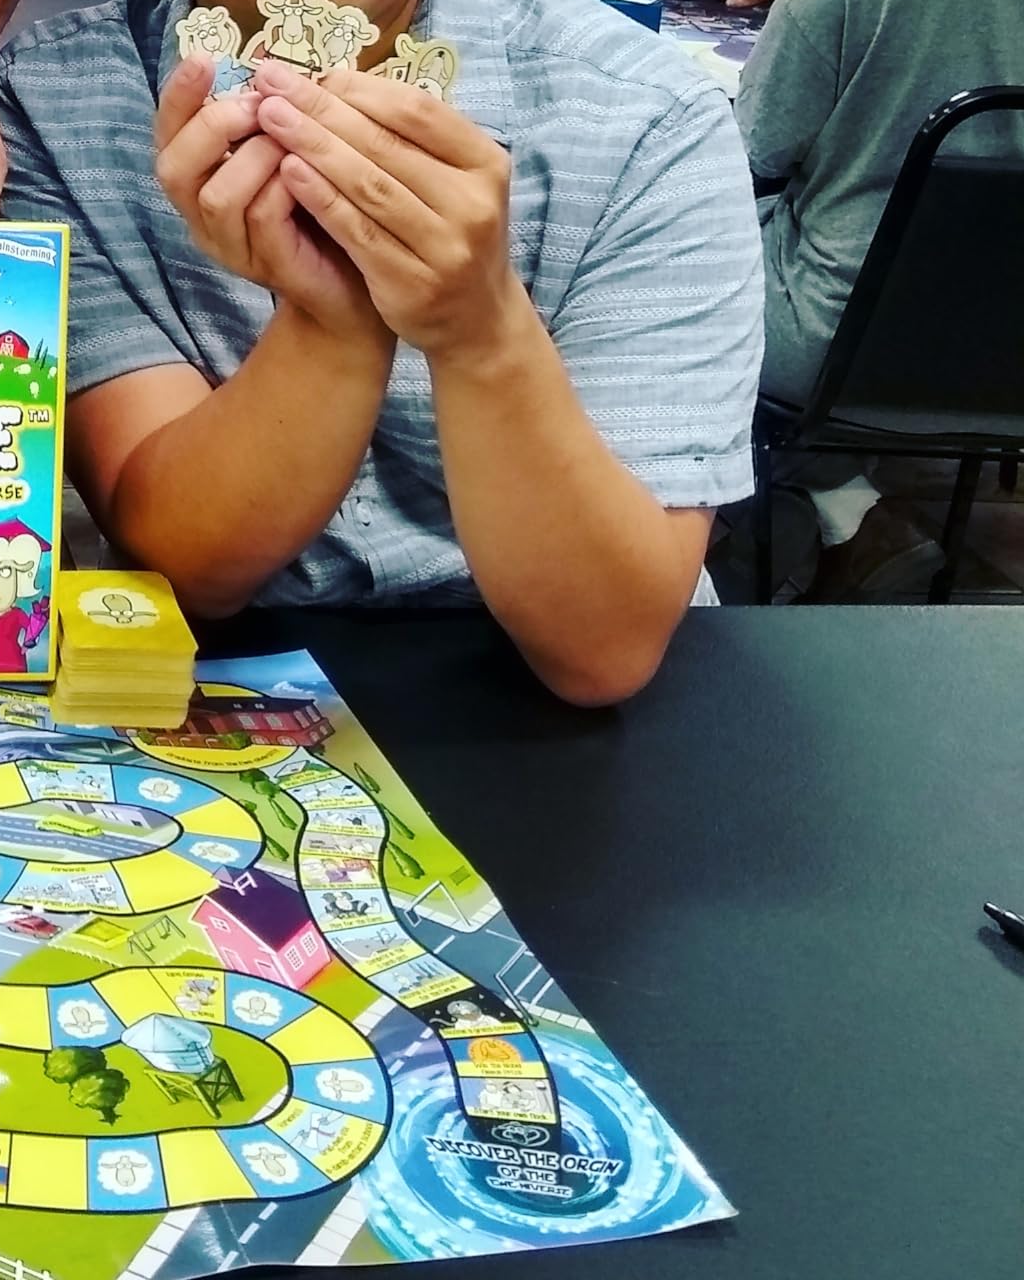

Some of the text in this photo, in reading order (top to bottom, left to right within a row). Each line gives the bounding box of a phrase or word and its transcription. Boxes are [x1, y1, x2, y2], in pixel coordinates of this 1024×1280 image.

[427, 1137, 621, 1174] DISCOVER THE ORGIN
[500, 1168, 556, 1182] OF THE
